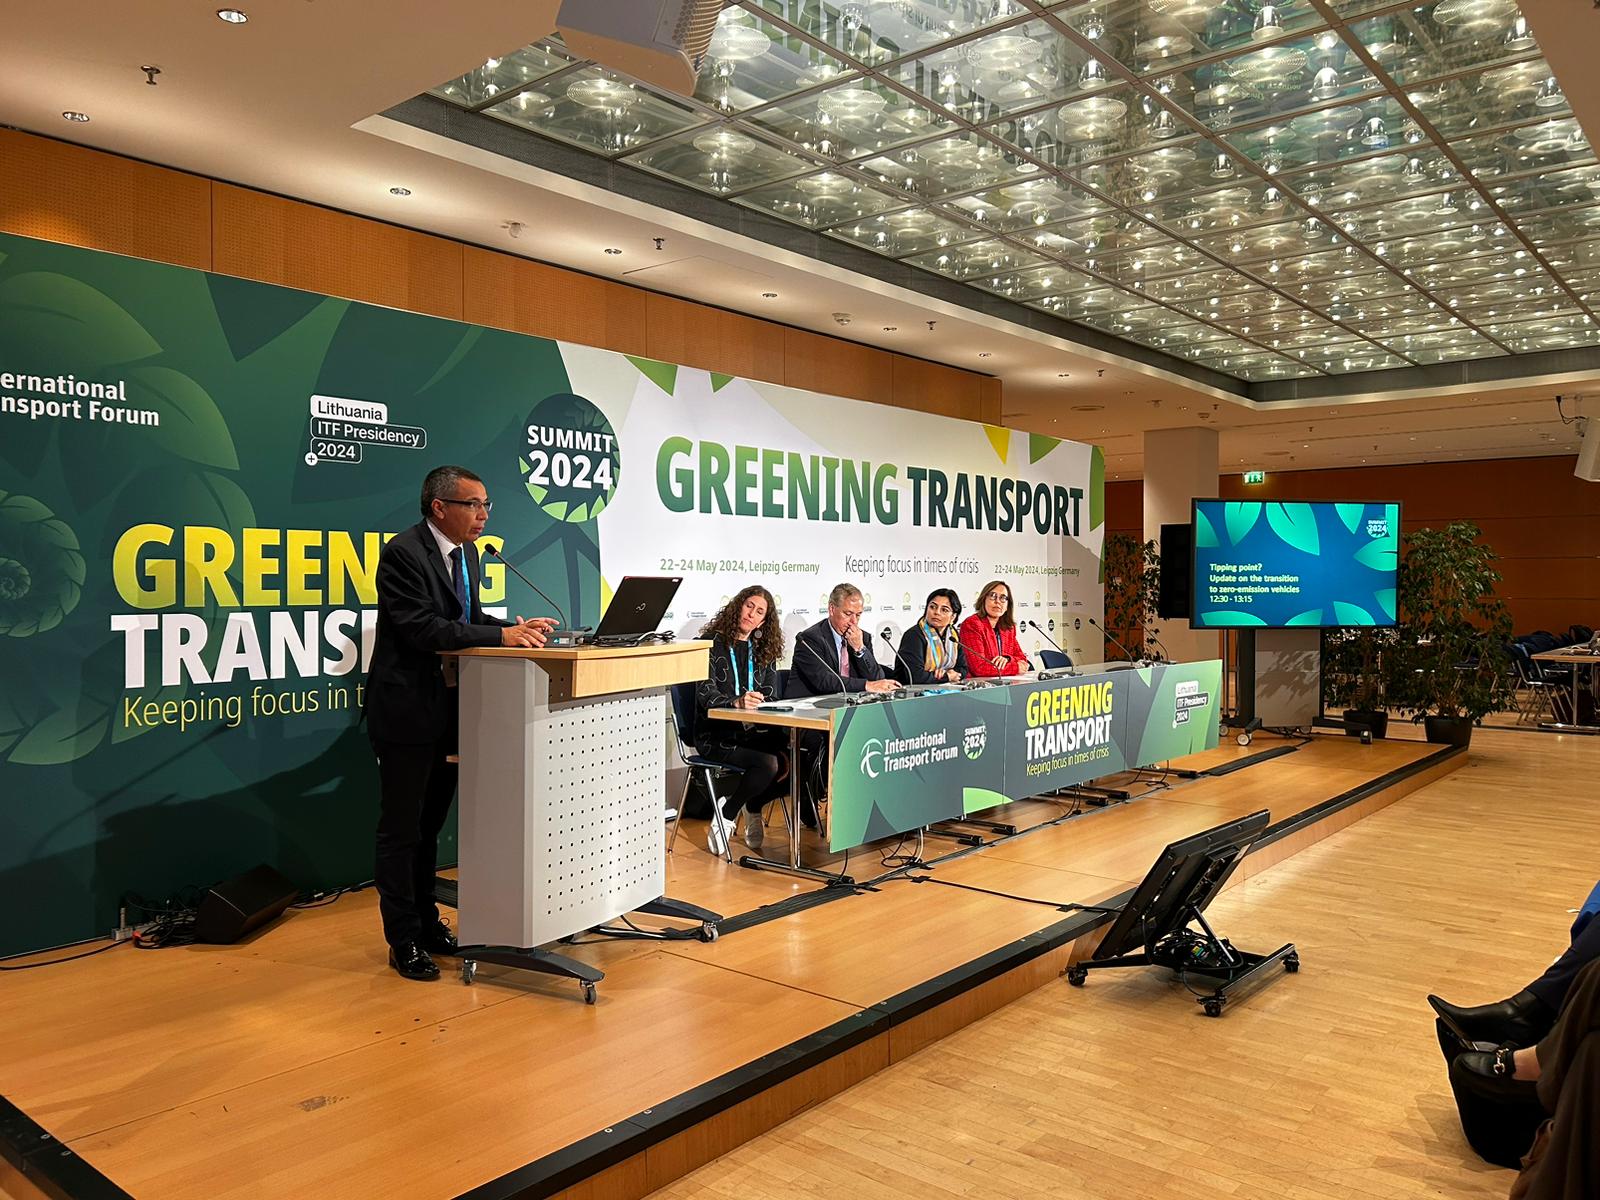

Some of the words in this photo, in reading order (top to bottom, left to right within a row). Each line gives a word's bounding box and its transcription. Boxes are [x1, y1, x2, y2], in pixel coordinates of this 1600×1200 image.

[89, 401, 160, 426] Forum
[318, 401, 383, 421] Lithuania
[318, 421, 341, 436] ITF
[344, 423, 420, 447] Presidency
[527, 424, 614, 454] SUMMIT
[317, 442, 355, 459] 2024
[528, 449, 613, 490] 2024
[655, 435, 899, 525] GREENING
[906, 466, 1084, 537] TRANSPORT
[1368, 524, 1387, 532] 2024
[113, 523, 506, 610] GREENG
[696, 559, 717, 575] May
[719, 560, 748, 573] 2024,
[749, 560, 780, 575] Leipzig
[781, 561, 820, 575] Germany
[845, 554, 885, 578] Keeping
[887, 554, 912, 573] focus
[913, 555, 922, 573] in
[923, 556, 948, 573] times
[949, 556, 959, 573] of
[959, 557, 980, 574] crisis
[1013, 565, 1025, 576] May
[1041, 566, 1058, 576] Leipzig
[1058, 566, 1080, 577] Germany
[1209, 563, 1237, 573] Tipping
[1238, 562, 1263, 573] point?
[1209, 574, 1237, 584] Update
[1250, 574, 1262, 582] the
[1264, 574, 1299, 582] transition
[1209, 585, 1218, 593] to
[1219, 585, 1270, 593] zero-emission
[1271, 585, 1300, 593] vehicles
[1210, 595, 1229, 603] 12:30
[1233, 595, 1253, 603] 13:15
[111, 607, 507, 689] TRANS
[123, 691, 242, 732] Keeping
[250, 686, 319, 716] focus
[327, 682, 348, 710] in
[1026, 681, 1113, 728] GREENING
[884, 728, 946, 755] International
[964, 725, 986, 736] SUMMIT
[965, 734, 985, 748] 2024
[1025, 714, 1113, 761] TRANSPORT
[883, 751, 930, 773] Transport
[930, 746, 959, 763] Forum
[1026, 760, 1051, 777] Keeping
[1052, 756, 1068, 770] focus
[1068, 753, 1074, 765] in
[1074, 751, 1089, 764] times
[1089, 747, 1097, 760] of
[1096, 745, 1109, 759] crisis
